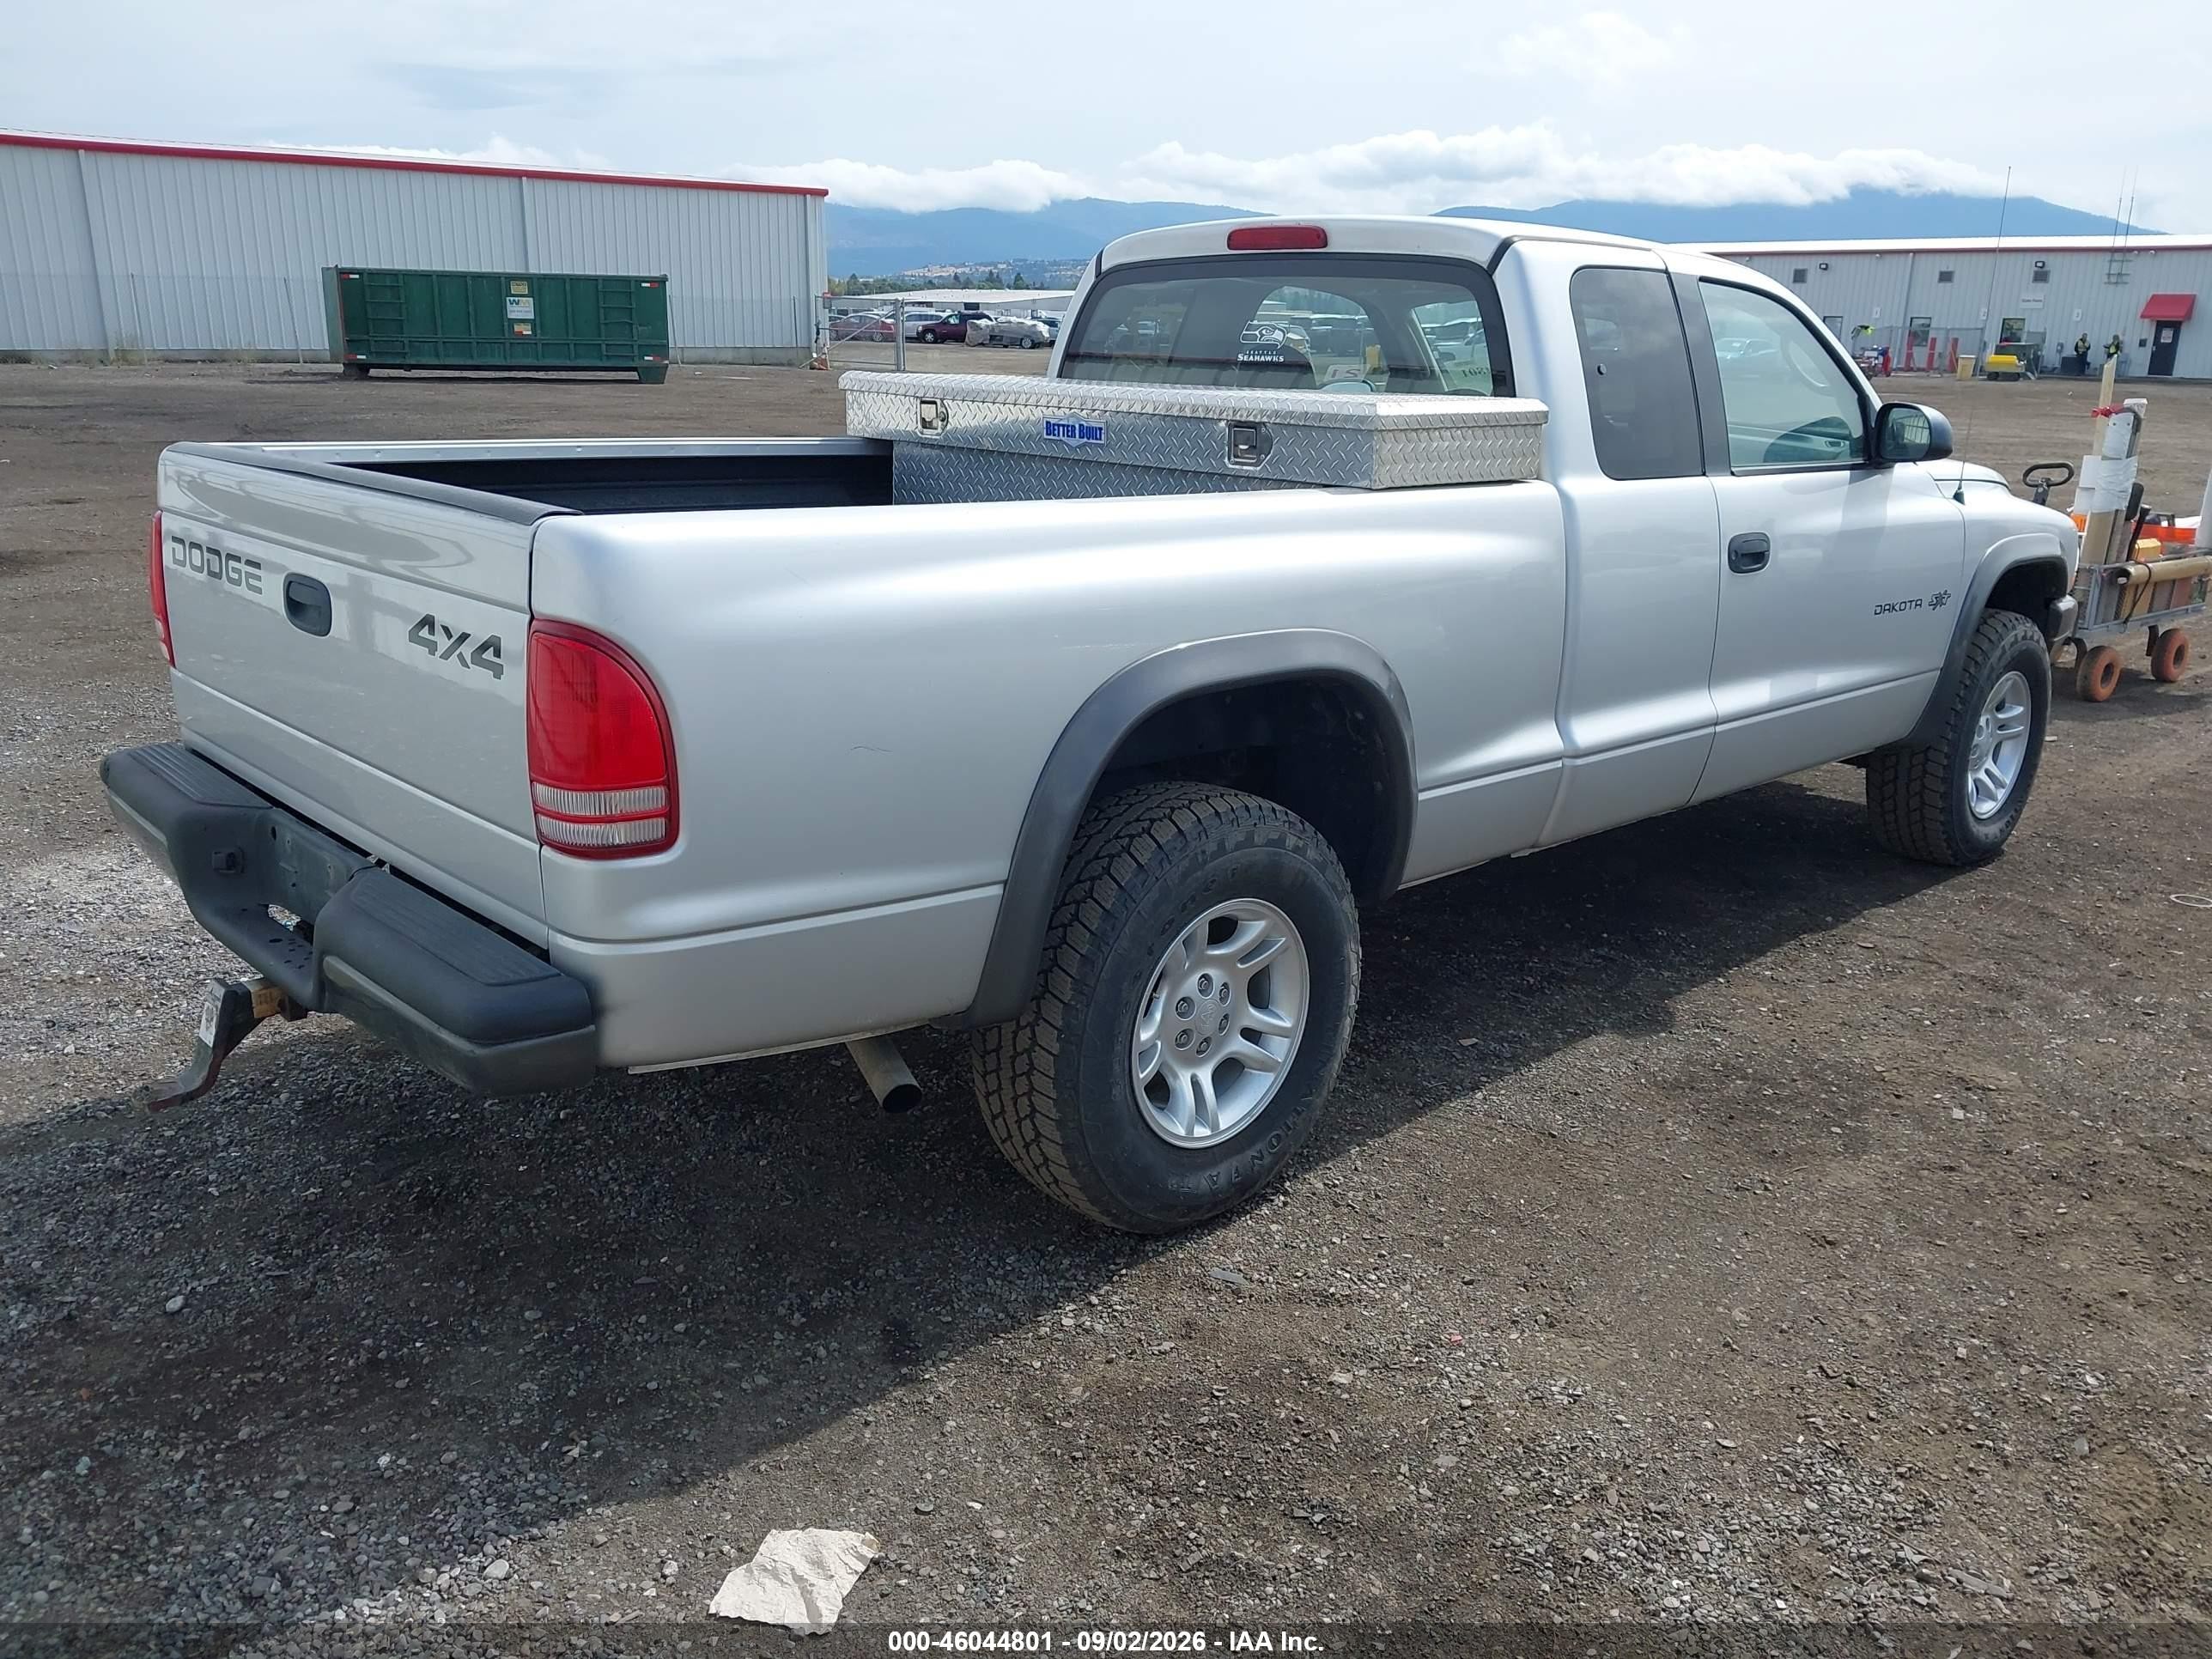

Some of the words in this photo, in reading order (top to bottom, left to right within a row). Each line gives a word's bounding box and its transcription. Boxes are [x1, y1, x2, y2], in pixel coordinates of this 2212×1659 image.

[1237, 353, 1285, 362] SEAHAWKS
[1045, 420, 1077, 439] BETTER
[1079, 423, 1103, 441] BUILT
[171, 535, 263, 595] DODGE
[1874, 599, 1923, 615] DAKOTA
